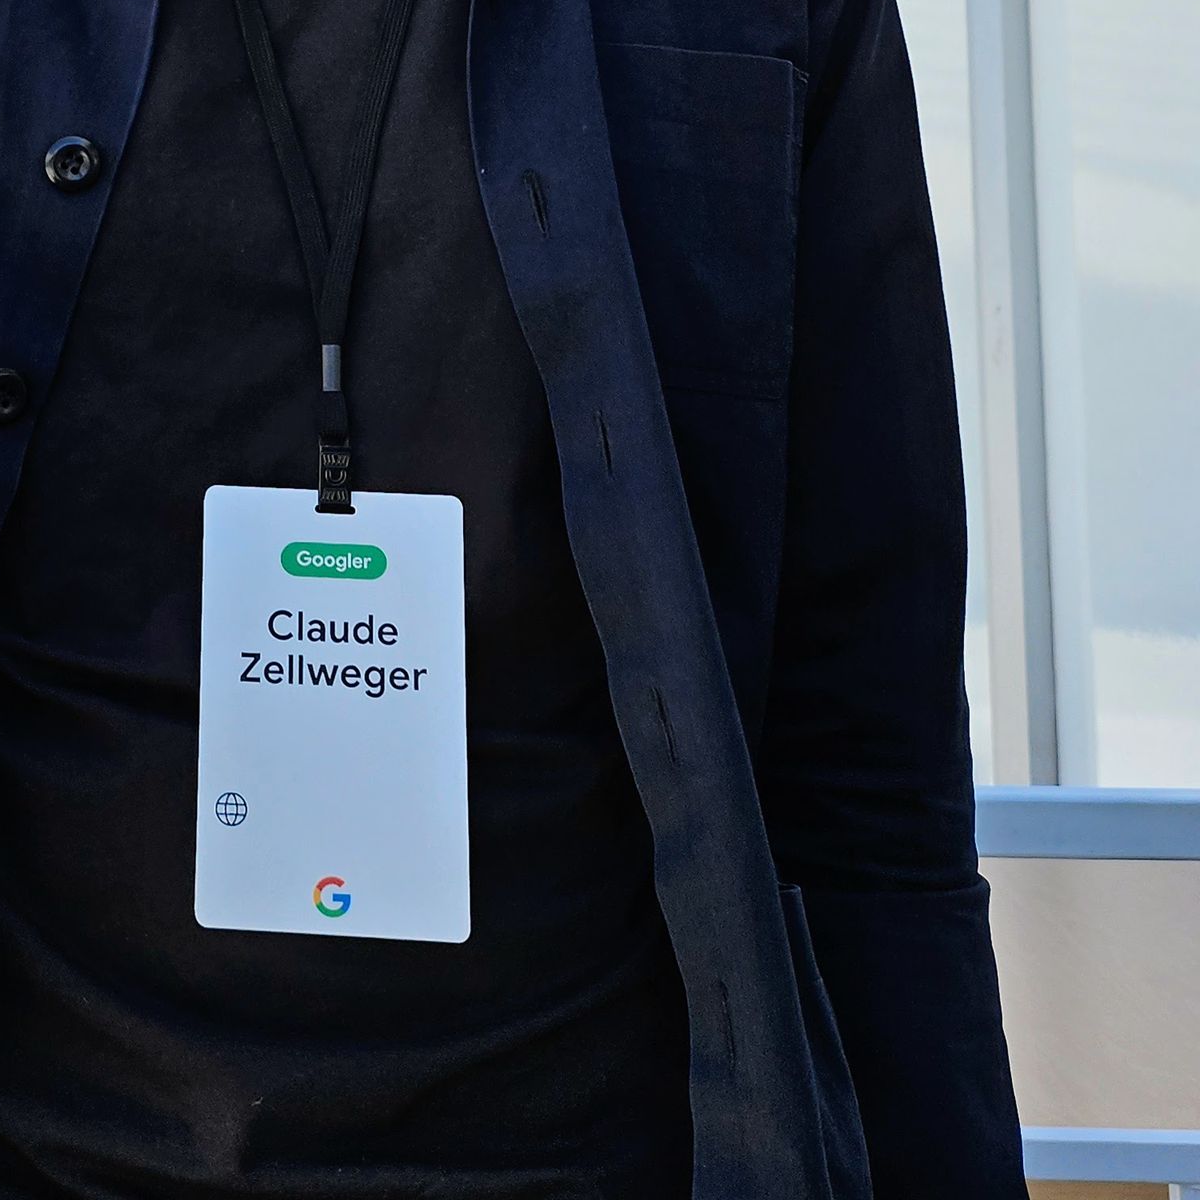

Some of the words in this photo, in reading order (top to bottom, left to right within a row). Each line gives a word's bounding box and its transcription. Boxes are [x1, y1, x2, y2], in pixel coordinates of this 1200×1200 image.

[296, 550, 372, 572] Googler
[267, 609, 399, 646] Claude
[239, 651, 428, 698] Zellweger
[313, 876, 352, 918] G
